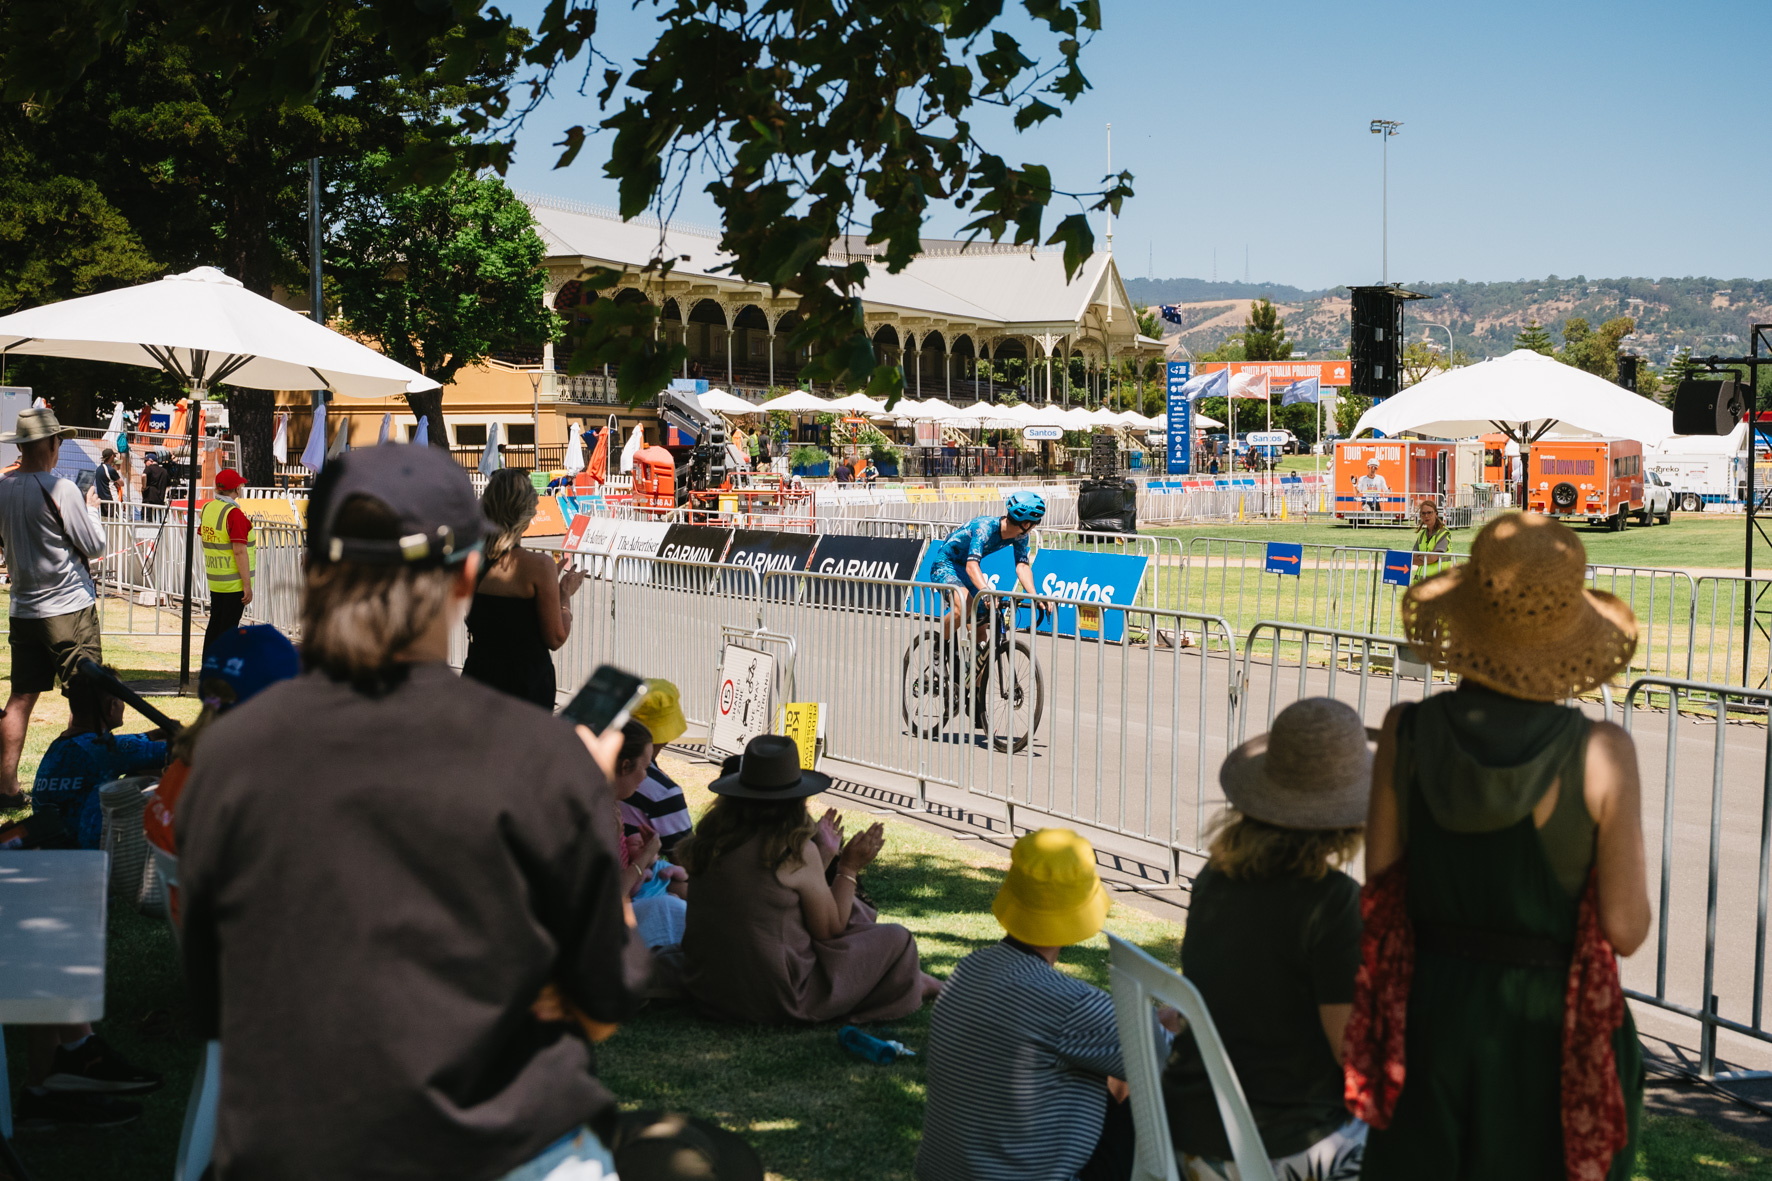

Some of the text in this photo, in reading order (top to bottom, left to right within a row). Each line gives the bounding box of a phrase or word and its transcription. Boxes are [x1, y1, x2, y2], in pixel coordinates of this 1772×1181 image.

[1241, 365, 1322, 377] SOUTH AUSTRALIA PROLOGUE
[149, 420, 166, 430] dget
[1029, 429, 1057, 437] Santos
[1252, 434, 1282, 443] Santos
[1343, 446, 1361, 461] TOUR
[1375, 446, 1400, 461] ACTION
[1540, 459, 1595, 476] TOUR DOWN UNDER
[649, 498, 663, 506] SJ46
[664, 498, 673, 507] AJ
[203, 525, 215, 536] SRS
[617, 535, 660, 552] The Advertiser
[663, 543, 714, 563] GARMIN
[205, 555, 231, 569] URITY
[732, 550, 797, 574] GARMIN
[819, 557, 899, 580] GARMIN
[1040, 573, 1115, 612] Santos
[723, 689, 731, 705] 15
[731, 678, 741, 721] SHARED
[758, 671, 770, 732] DESTRIANS
[748, 707, 756, 733] GIVE
[791, 710, 800, 741] KE
[805, 704, 813, 744] CROSS
[808, 705, 817, 769] PEDESTRIA
